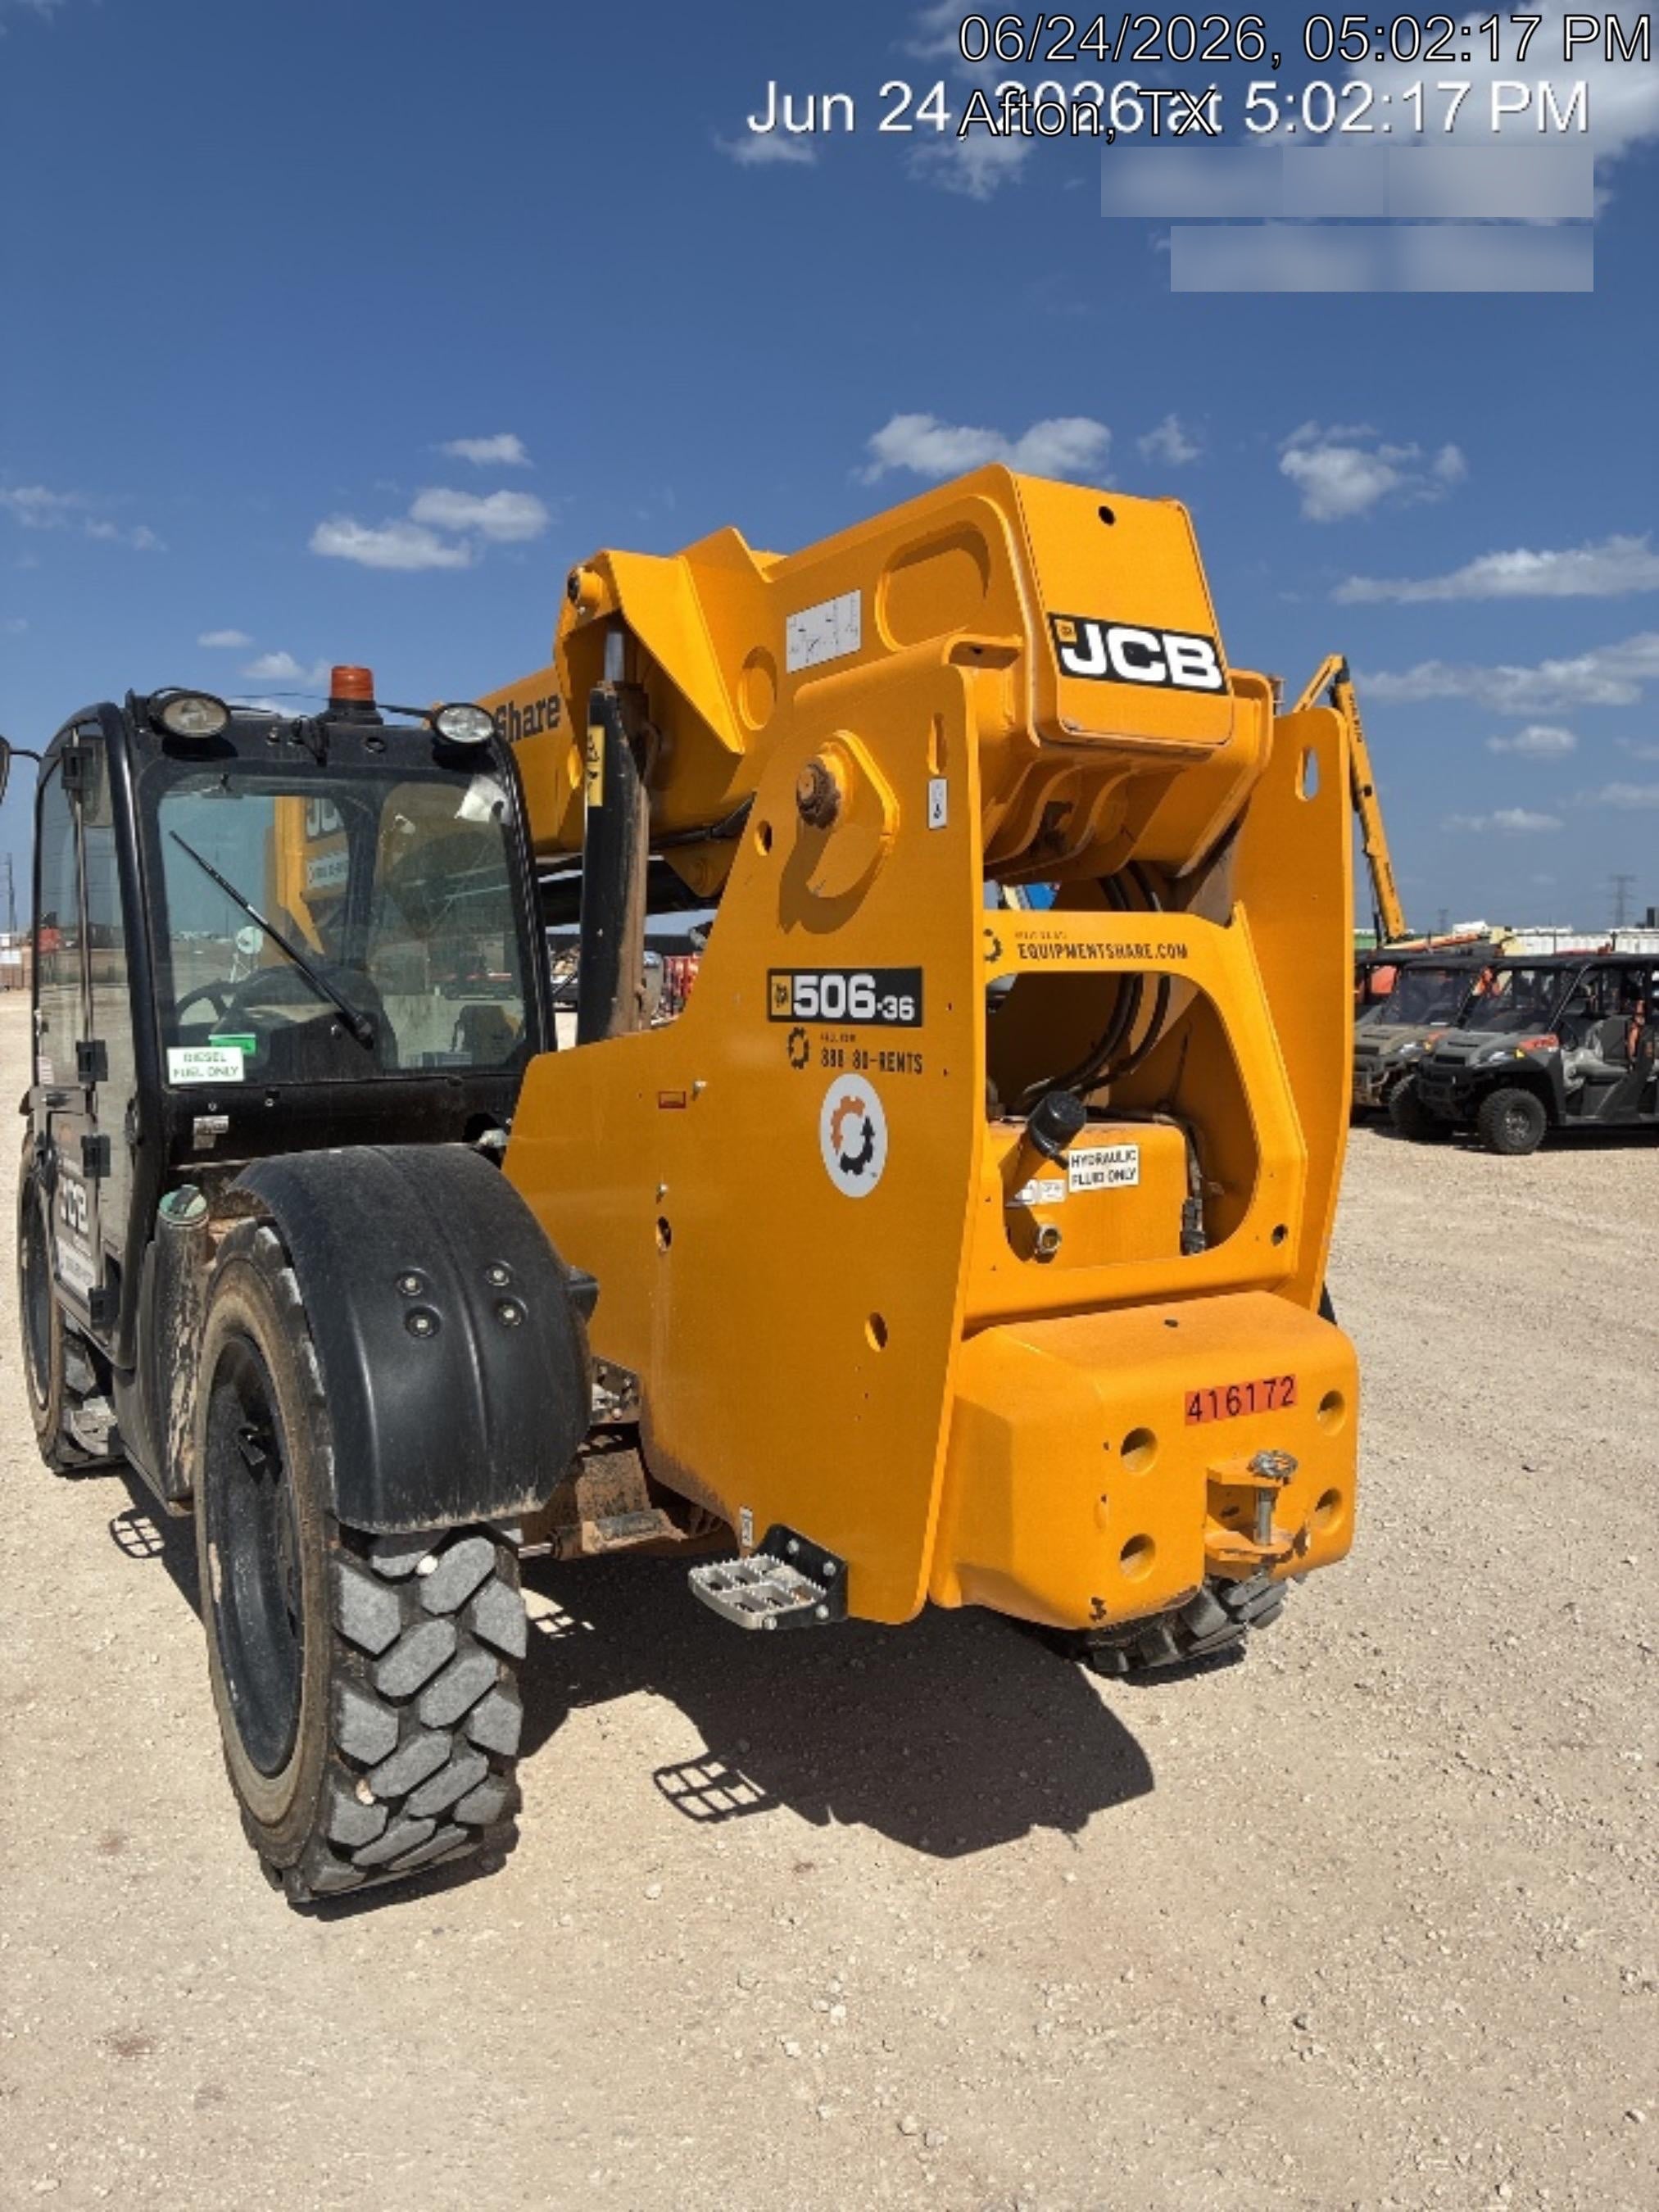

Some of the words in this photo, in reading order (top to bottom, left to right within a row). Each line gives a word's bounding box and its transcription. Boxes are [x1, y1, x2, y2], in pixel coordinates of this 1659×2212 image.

[1061, 623, 1223, 689] JCB
[1017, 942, 1188, 960] EQUIPMENTSHARE.COM
[1072, 1149, 1136, 1168] HYDRAULIC
[1072, 1172, 1105, 1186] FLUID
[1108, 1167, 1136, 1183] ONLY
[1188, 1376, 1294, 1422] 416172
